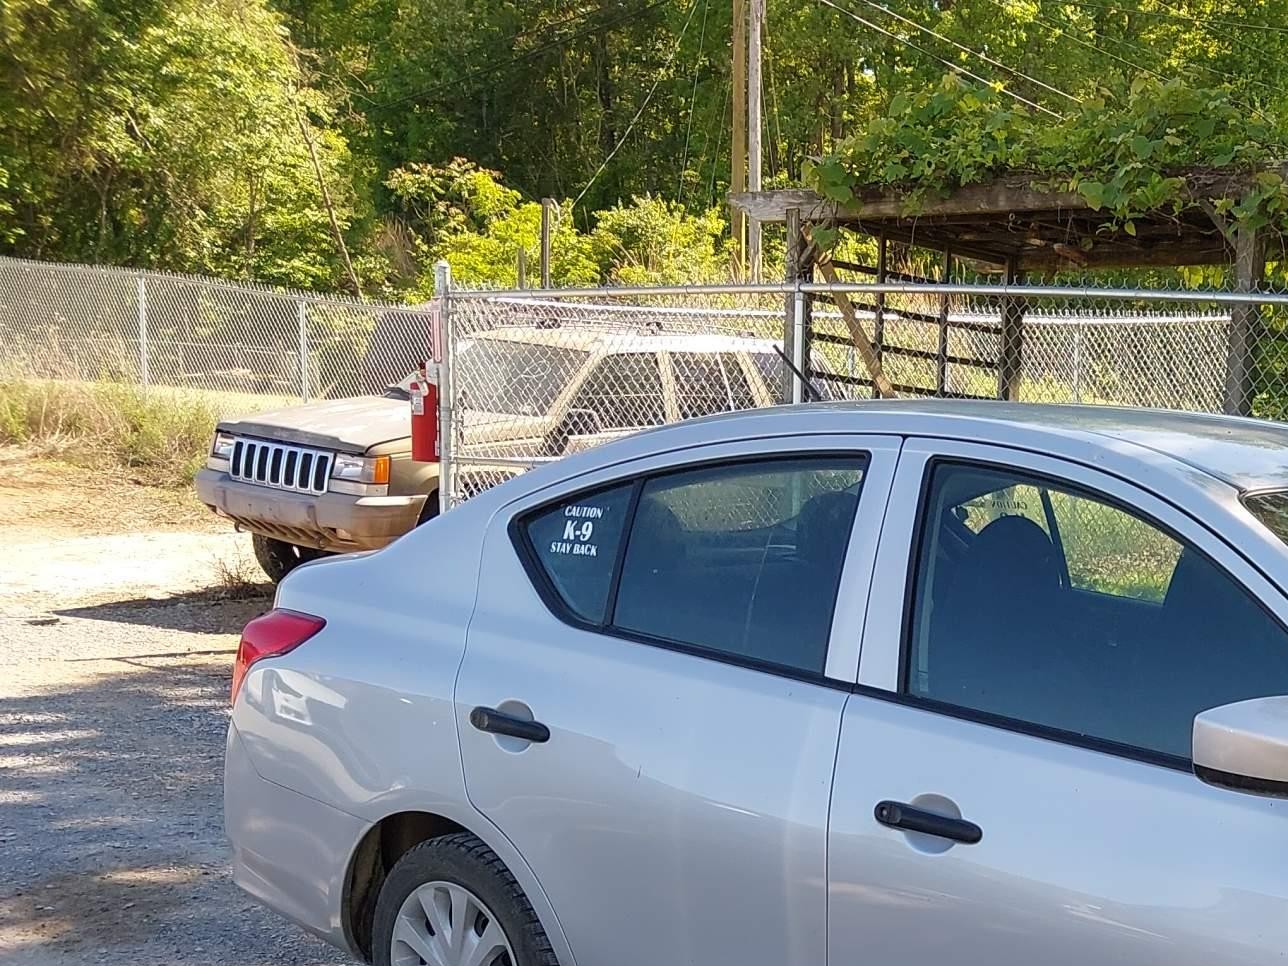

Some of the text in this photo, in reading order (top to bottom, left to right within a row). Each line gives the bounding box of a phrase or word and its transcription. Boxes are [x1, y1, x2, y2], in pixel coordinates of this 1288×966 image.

[565, 506, 603, 518] CAUTION
[563, 520, 593, 541] K-9
[550, 542, 597, 556] STAY BACK
